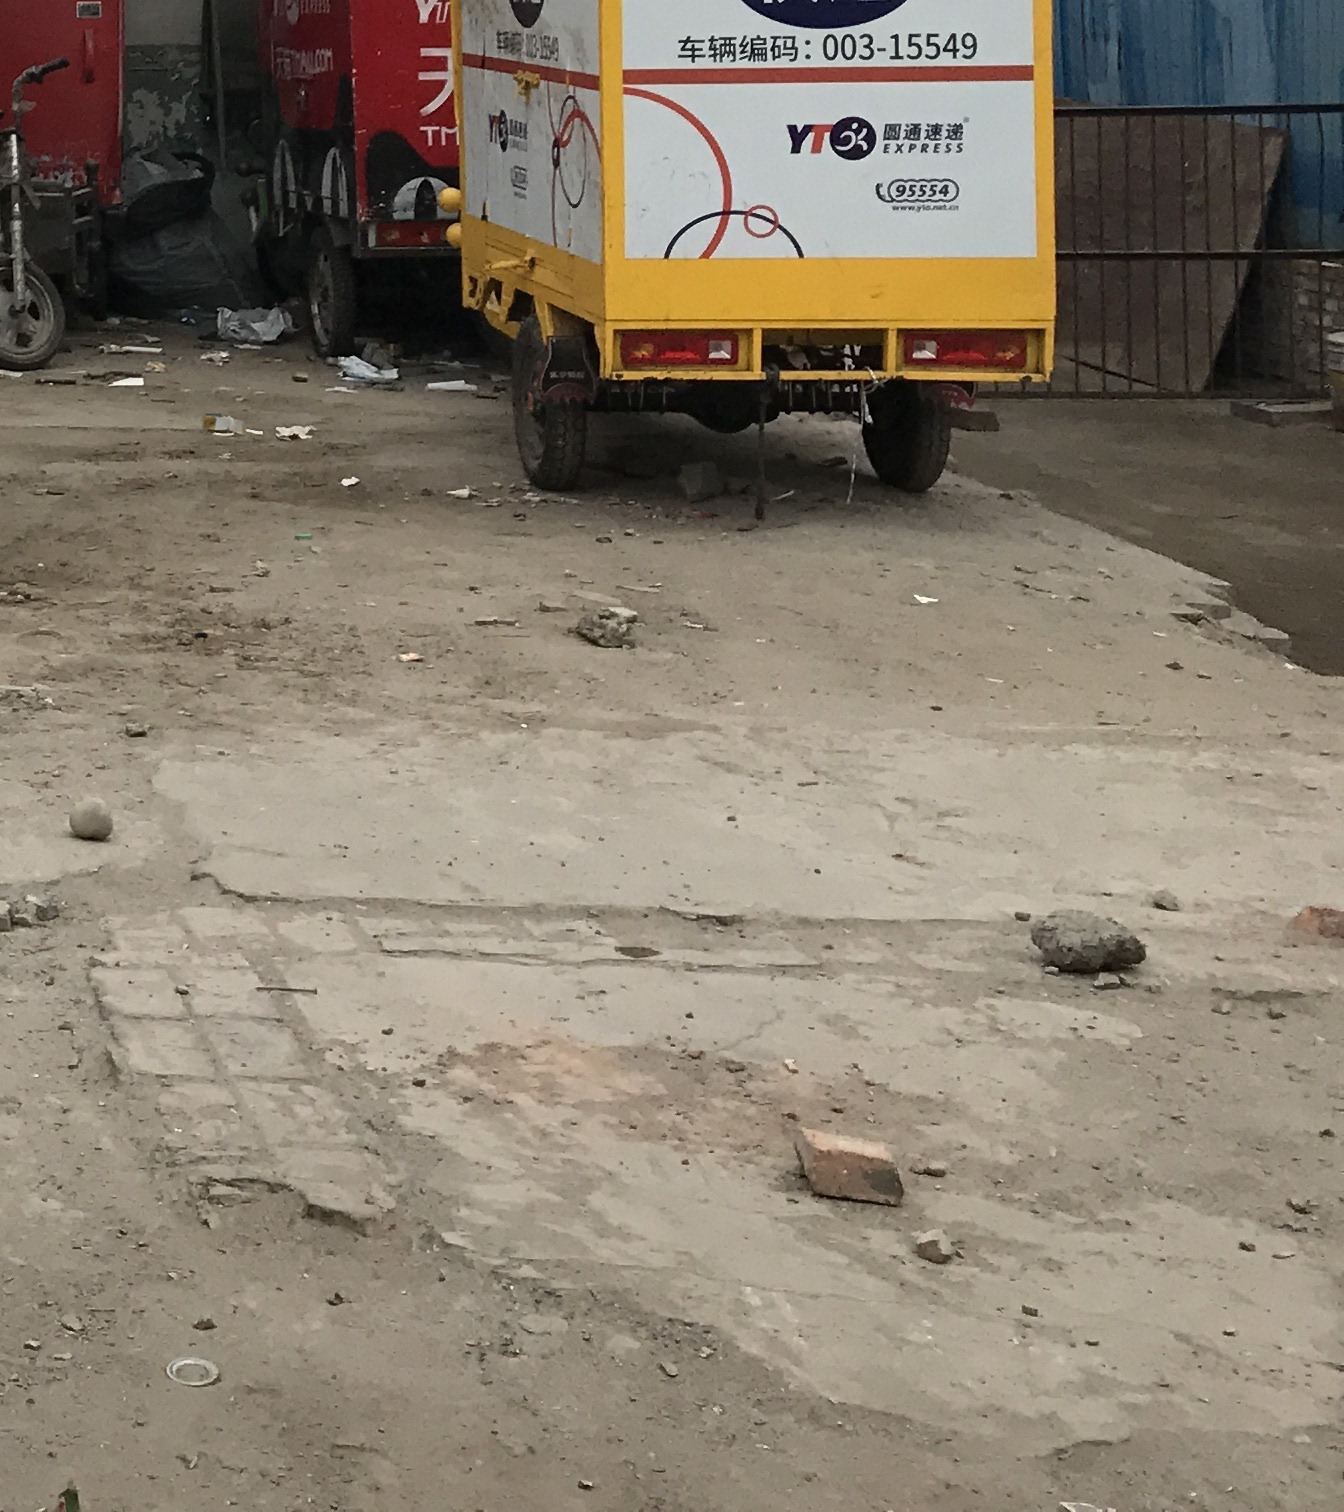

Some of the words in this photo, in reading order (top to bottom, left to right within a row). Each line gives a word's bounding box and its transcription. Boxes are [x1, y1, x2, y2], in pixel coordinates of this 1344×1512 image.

[883, 123, 964, 141] 圆通速递
[883, 143, 964, 154] EXPRESS
[895, 183, 951, 198] 95554
